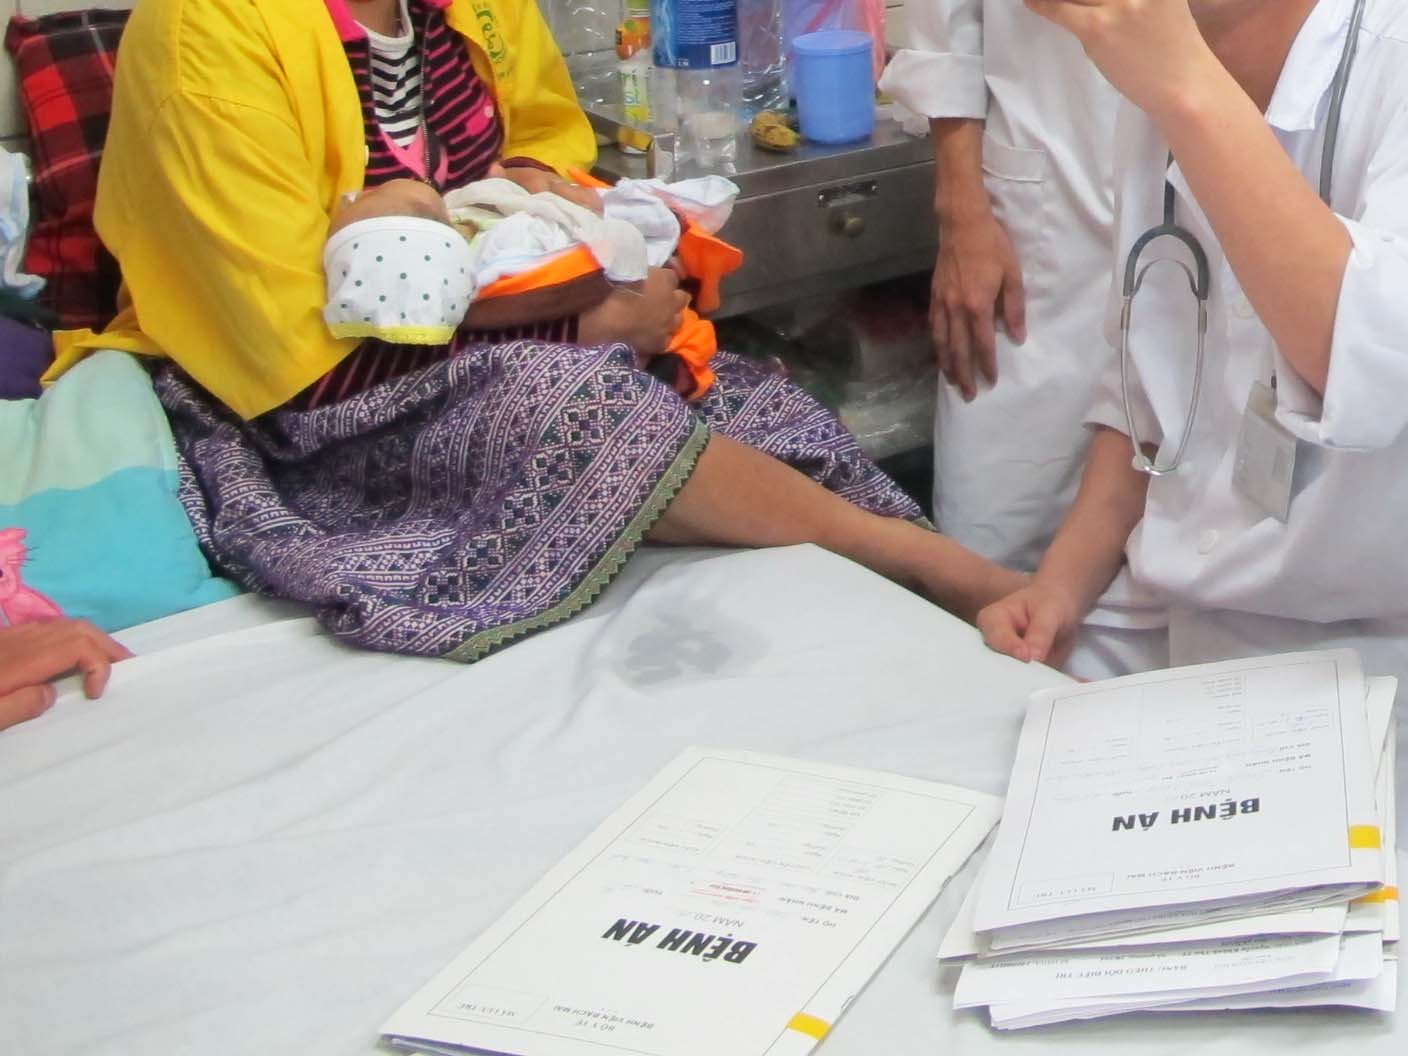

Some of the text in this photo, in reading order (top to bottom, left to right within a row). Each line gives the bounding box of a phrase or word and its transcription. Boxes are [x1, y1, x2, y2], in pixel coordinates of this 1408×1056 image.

[1111, 798, 1260, 832] BỆNH ÁN
[600, 918, 758, 964] BỆNH ÁN
